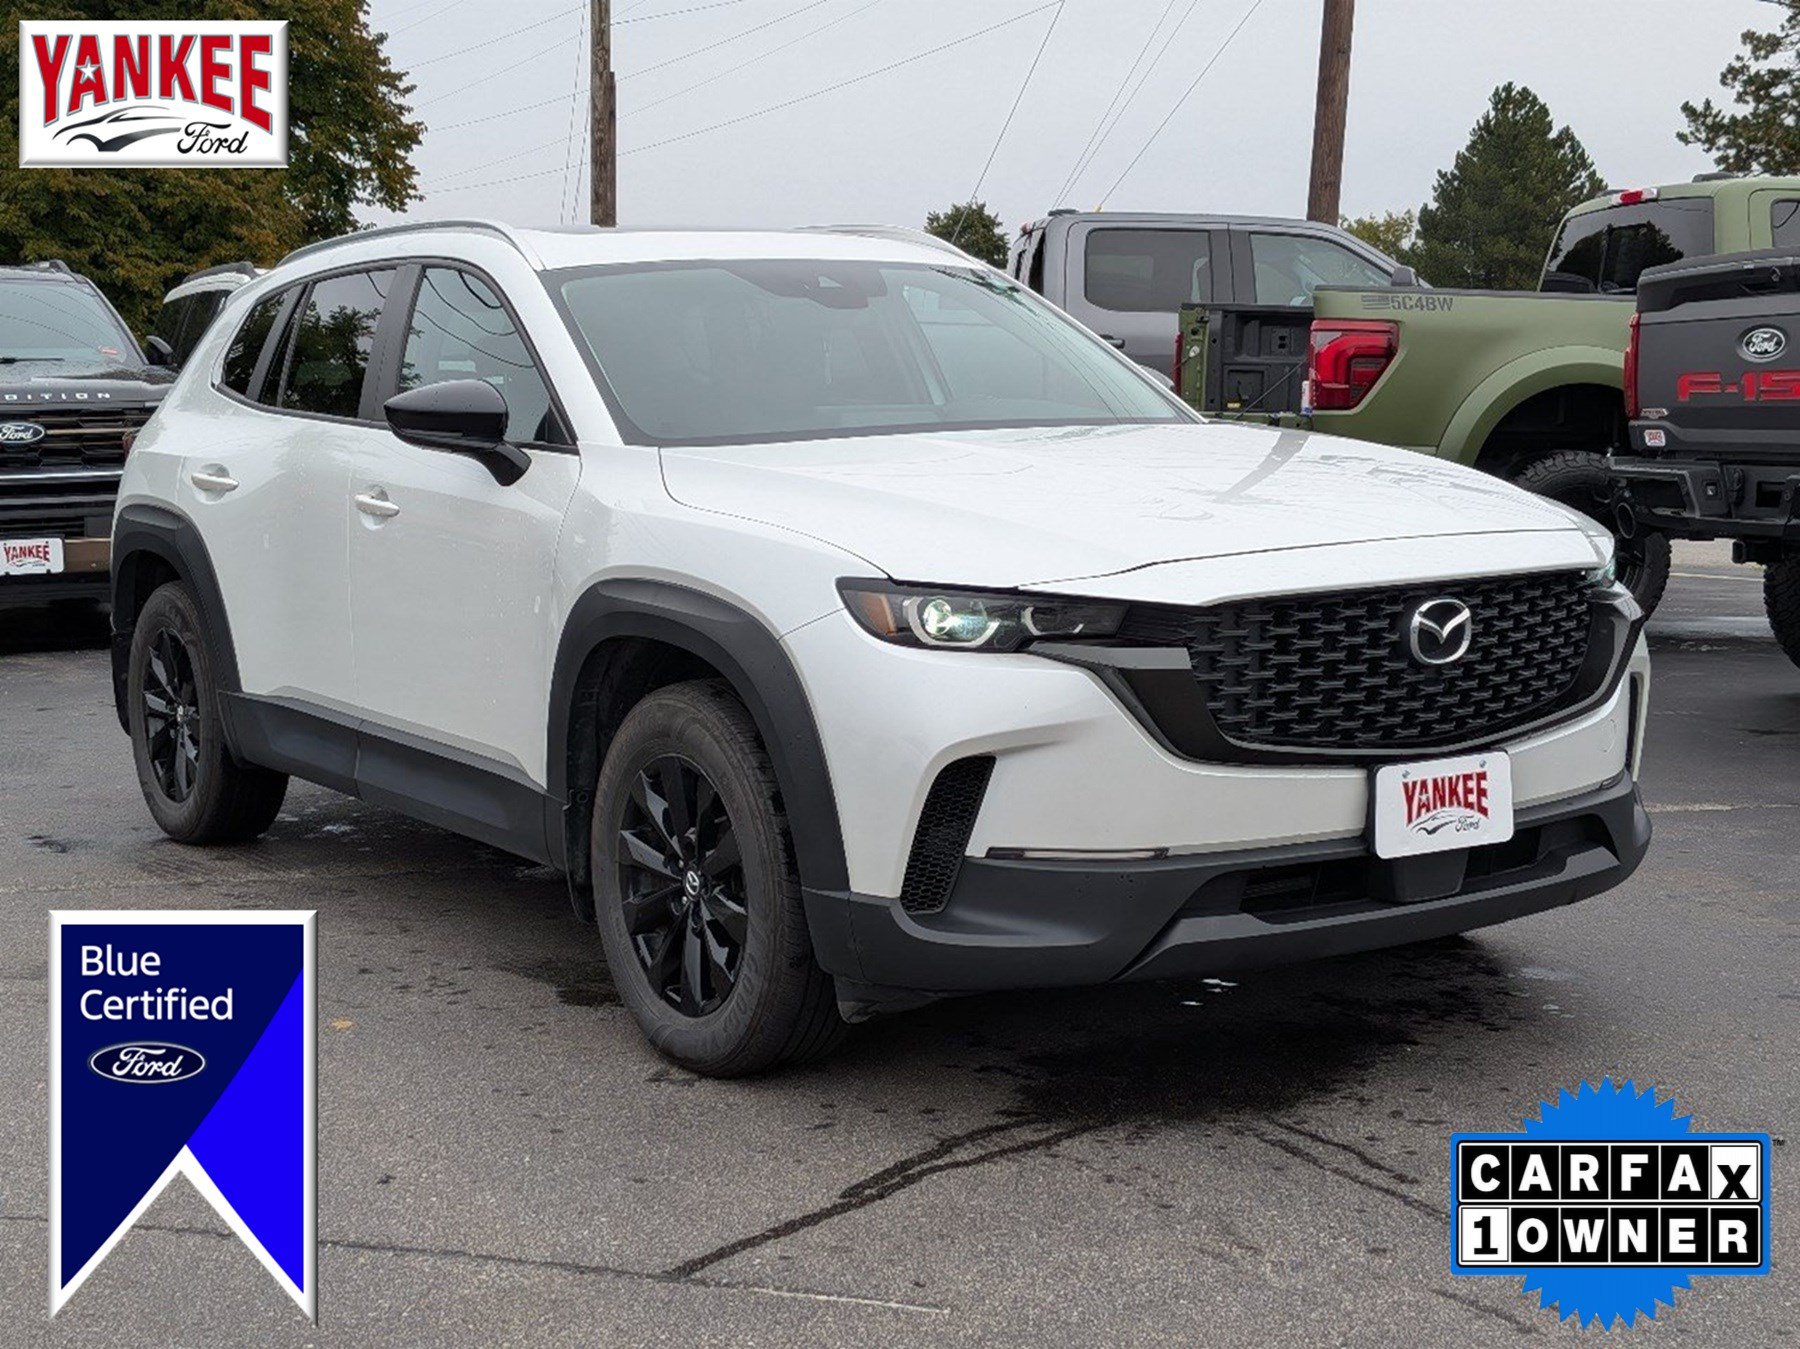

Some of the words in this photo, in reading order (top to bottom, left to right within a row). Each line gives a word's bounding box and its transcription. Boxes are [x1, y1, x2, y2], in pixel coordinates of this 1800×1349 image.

[1749, 331, 1777, 352] Ford
[0, 426, 35, 440] Ford
[3, 544, 50, 564] YANKEE
[1402, 771, 1490, 826] YANKEE
[1455, 815, 1483, 833] Ford
